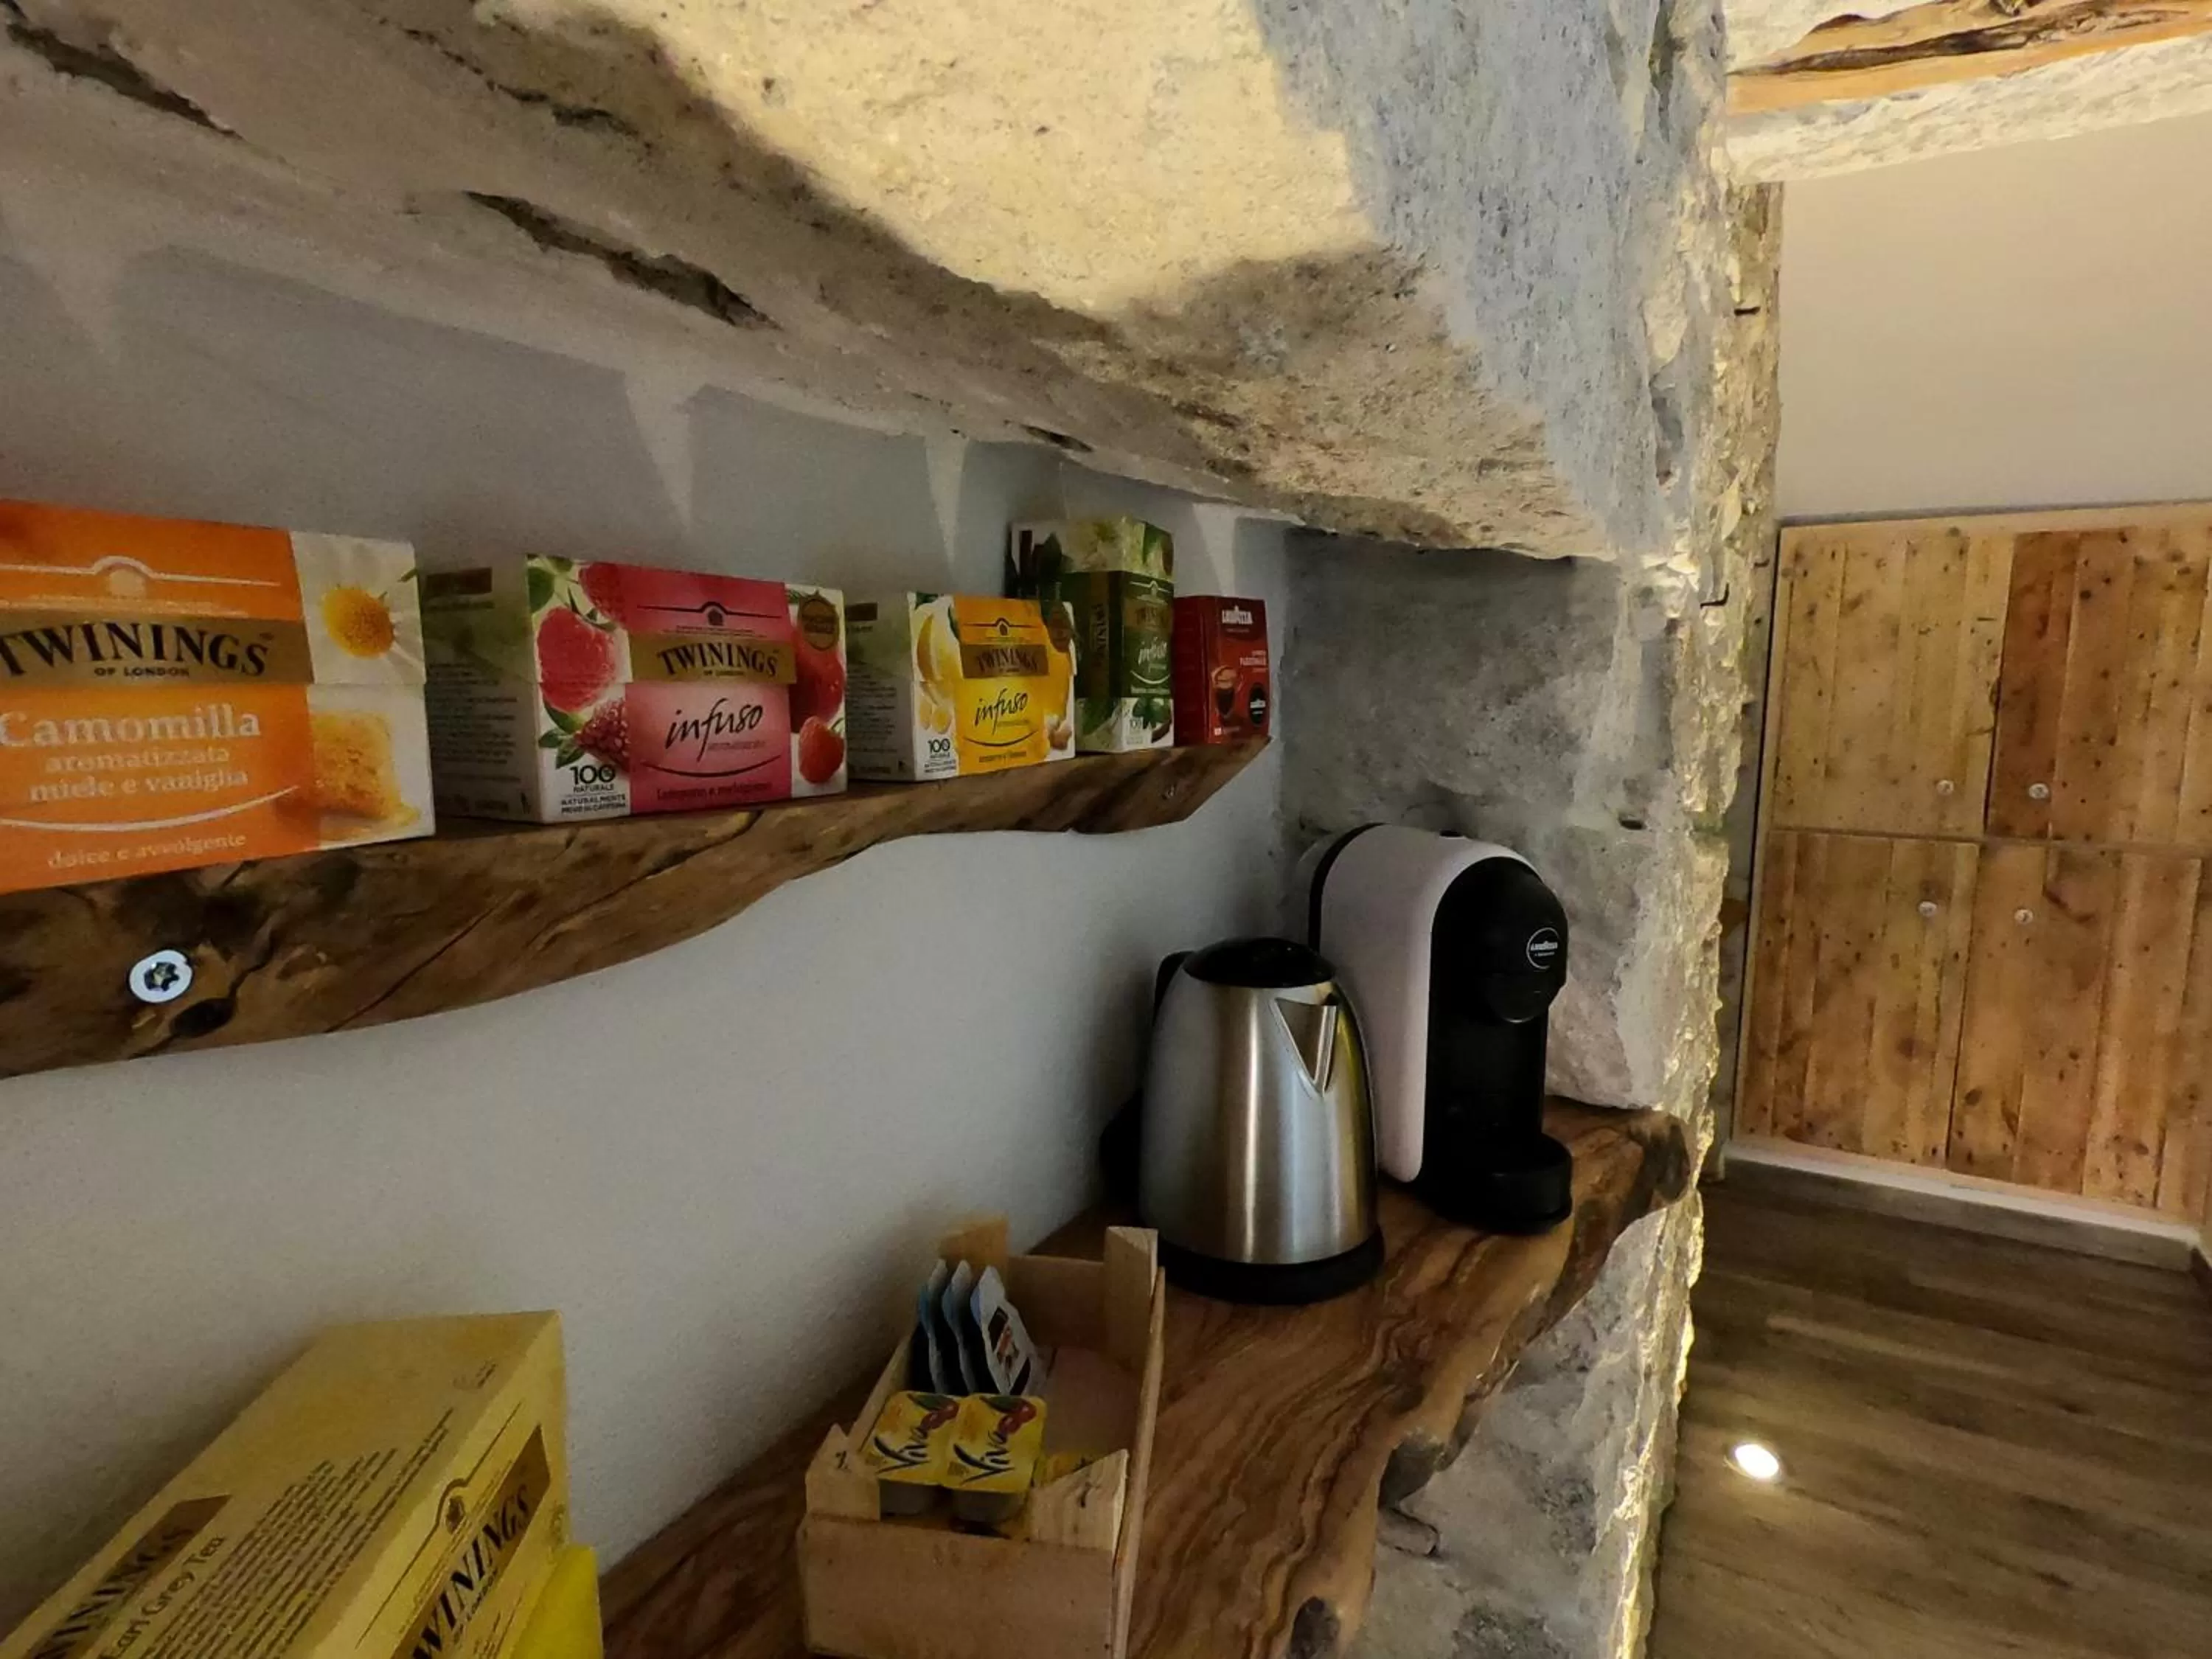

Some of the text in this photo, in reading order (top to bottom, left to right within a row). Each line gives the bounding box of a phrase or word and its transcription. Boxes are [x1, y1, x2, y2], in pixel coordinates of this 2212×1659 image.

[0, 622, 268, 678] TWININGS
[656, 641, 779, 678] TWININGS
[94, 667, 190, 678] OF LONDON
[0, 702, 261, 748] Camomilla
[973, 687, 1029, 736] infuso
[665, 698, 763, 763] infuso
[928, 738, 950, 754] 100
[45, 746, 230, 773] aromatizzata
[570, 765, 616, 785] 100
[29, 768, 248, 802] miele e vaniglia
[47, 833, 247, 870] dolce e avvolgente
[141, 1571, 195, 1615] Grey
[182, 1537, 226, 1566] Tea
